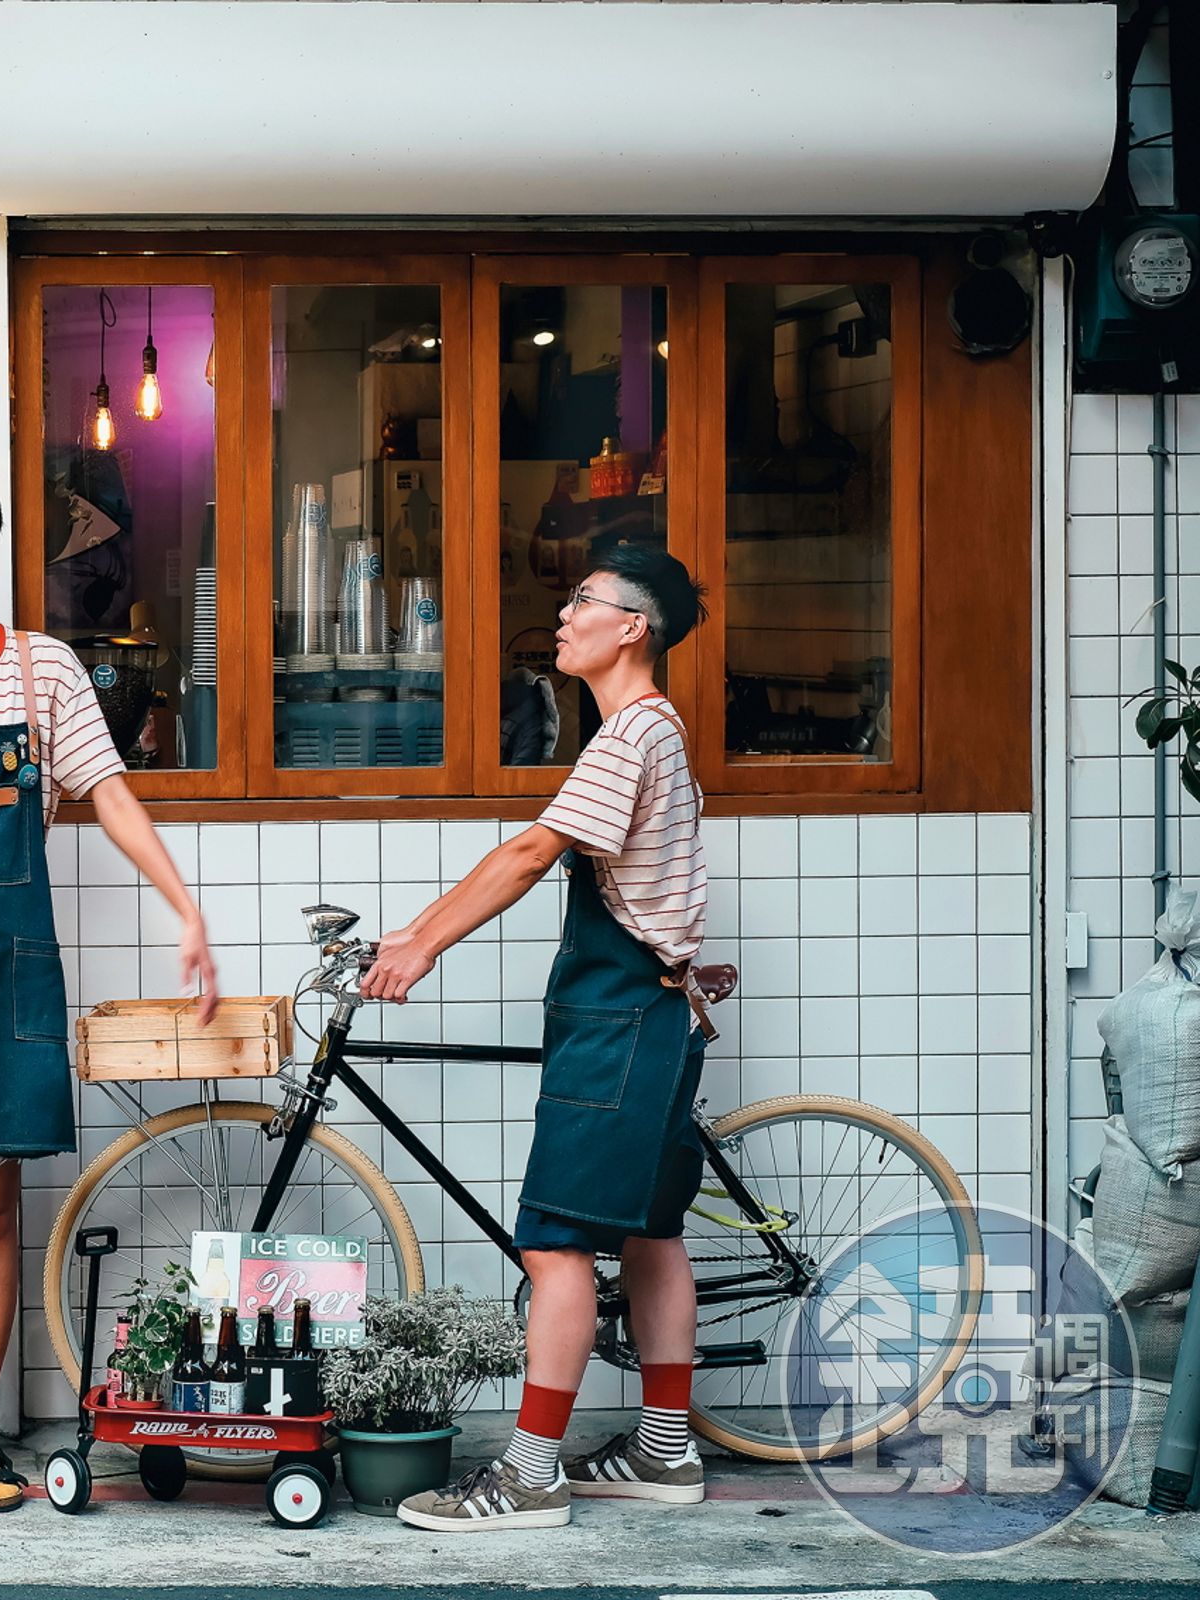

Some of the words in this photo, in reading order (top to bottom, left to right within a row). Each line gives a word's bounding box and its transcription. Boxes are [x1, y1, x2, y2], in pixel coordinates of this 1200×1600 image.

[250, 1238, 288, 1256] ICE
[296, 1239, 361, 1258] COLD
[246, 1266, 362, 1317] Beer
[308, 1326, 361, 1344] HERE
[129, 1420, 192, 1436] RADIO
[212, 1424, 276, 1440] FLYER
